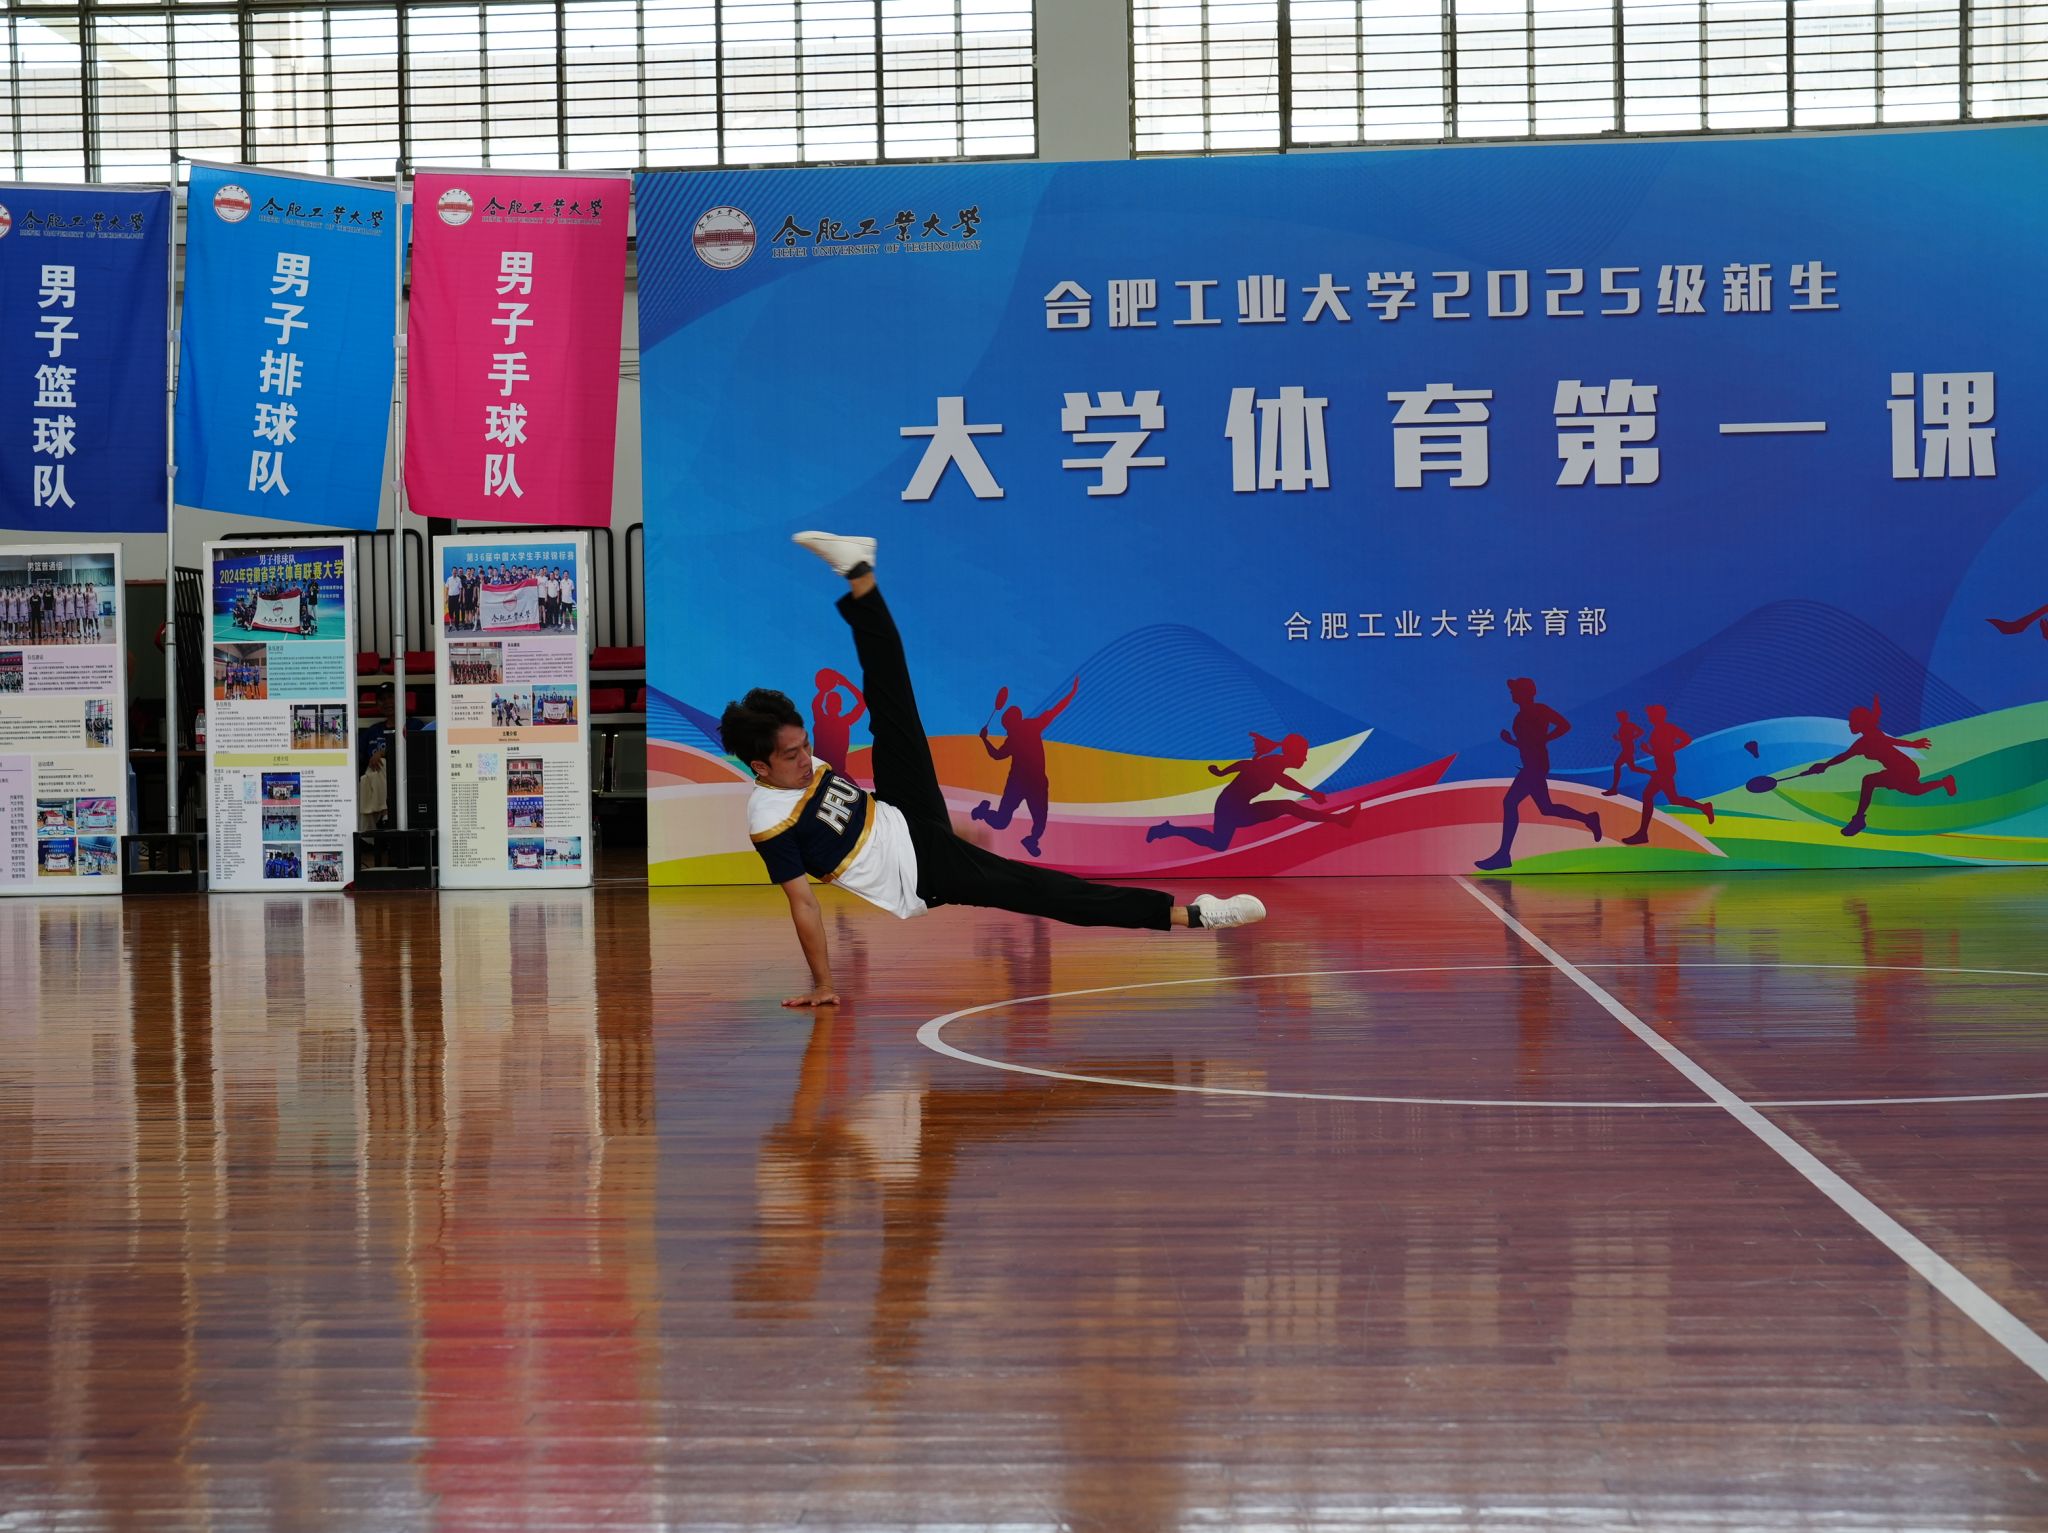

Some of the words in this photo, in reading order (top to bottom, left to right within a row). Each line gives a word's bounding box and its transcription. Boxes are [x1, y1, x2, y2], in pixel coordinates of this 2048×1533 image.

[771, 247, 807, 258] HEFEI
[812, 243, 880, 257] UNIVERSITY
[884, 242, 899, 253] OF
[904, 240, 982, 253] TECHNOLOGY
[1043, 260, 1840, 329] 合肥工业大学2025级新生
[33, 264, 79, 509] 男子篮球队
[248, 252, 312, 497] 男子排球队
[483, 251, 535, 499] 男子手球队
[900, 371, 1998, 501] 大学体育第一课
[1284, 607, 1607, 640] 合肥工业大学体育部
[816, 775, 859, 836] HFU
